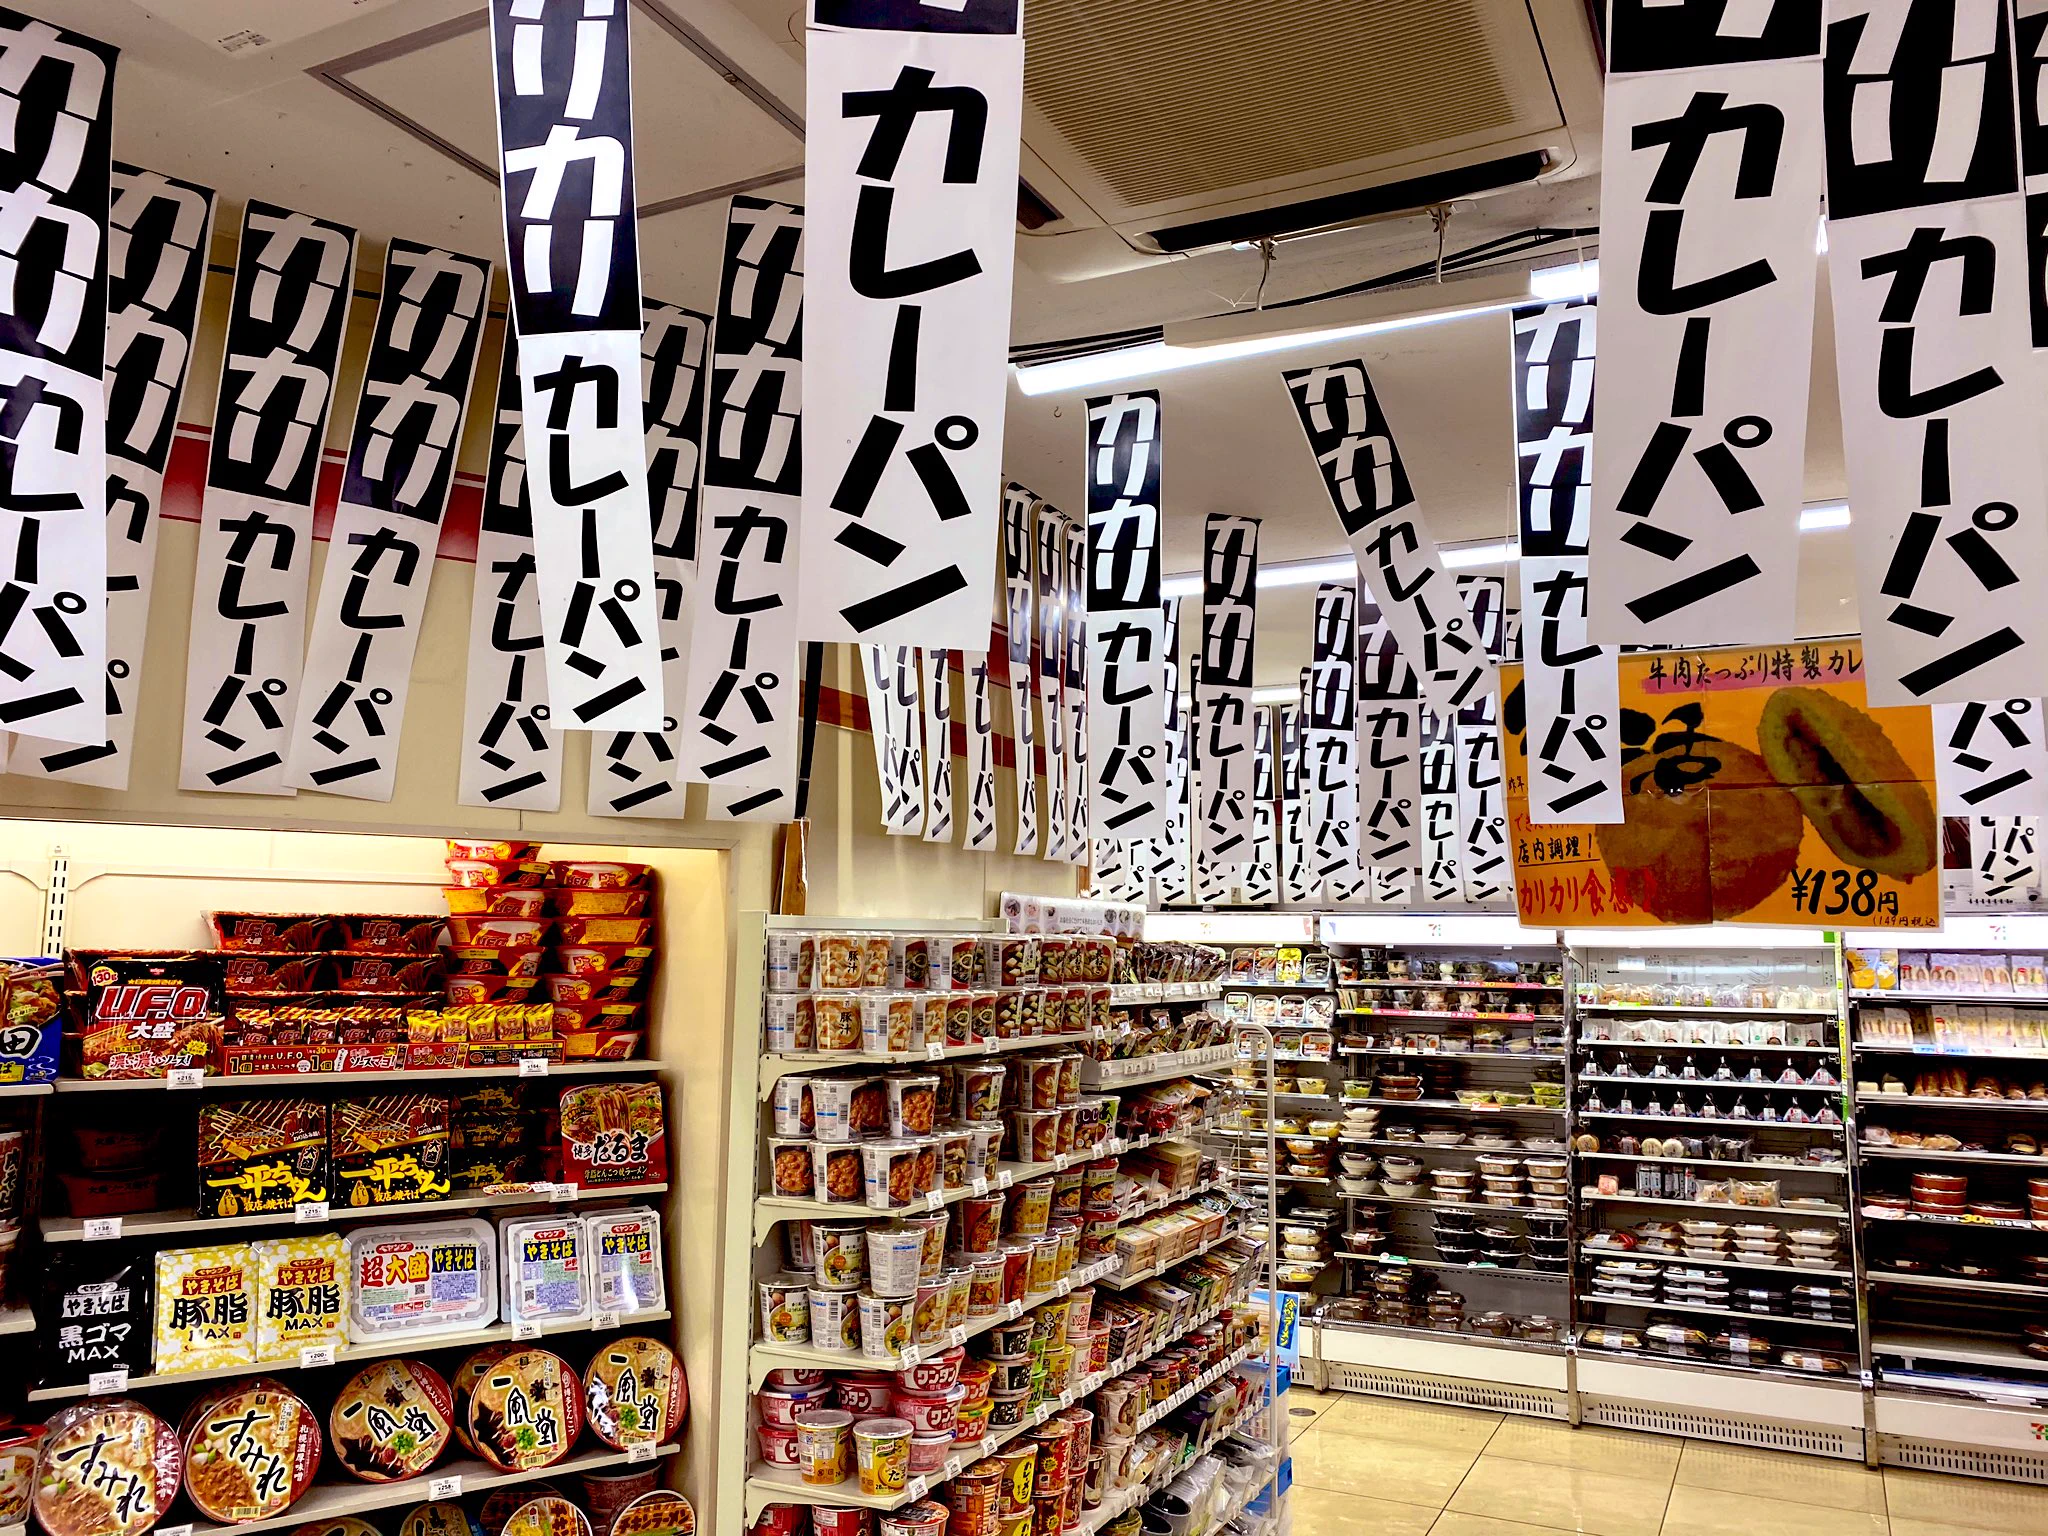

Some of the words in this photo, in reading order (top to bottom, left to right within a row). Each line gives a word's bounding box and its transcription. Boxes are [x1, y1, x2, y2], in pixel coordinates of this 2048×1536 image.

[829, 0, 989, 634] カレーパン
[1615, 0, 1786, 624] カレーパン
[128, 1022, 176, 1039] 大盛
[206, 1160, 326, 1202] 一平ちゃん
[340, 1153, 450, 1194] 一平ちゃん
[435, 1249, 474, 1271] やきそば
[526, 1241, 574, 1261] やきそば
[604, 1235, 648, 1255] やきそば
[185, 1276, 240, 1295] やきそば
[281, 1267, 332, 1285] やきそば
[360, 1252, 430, 1289] 超大盛
[66, 1295, 125, 1316] やきそば
[169, 1292, 248, 1330] 豚脂
[266, 1284, 341, 1320] 豚脂
[58, 1323, 132, 1349] 黒ゴマ
[284, 1316, 323, 1331] MAX
[67, 1345, 120, 1364] MAX
[611, 1354, 659, 1431] 一風堂
[492, 1377, 557, 1446] 一風堂
[211, 1410, 288, 1501] すみれ
[57, 1433, 150, 1523] すみれ
